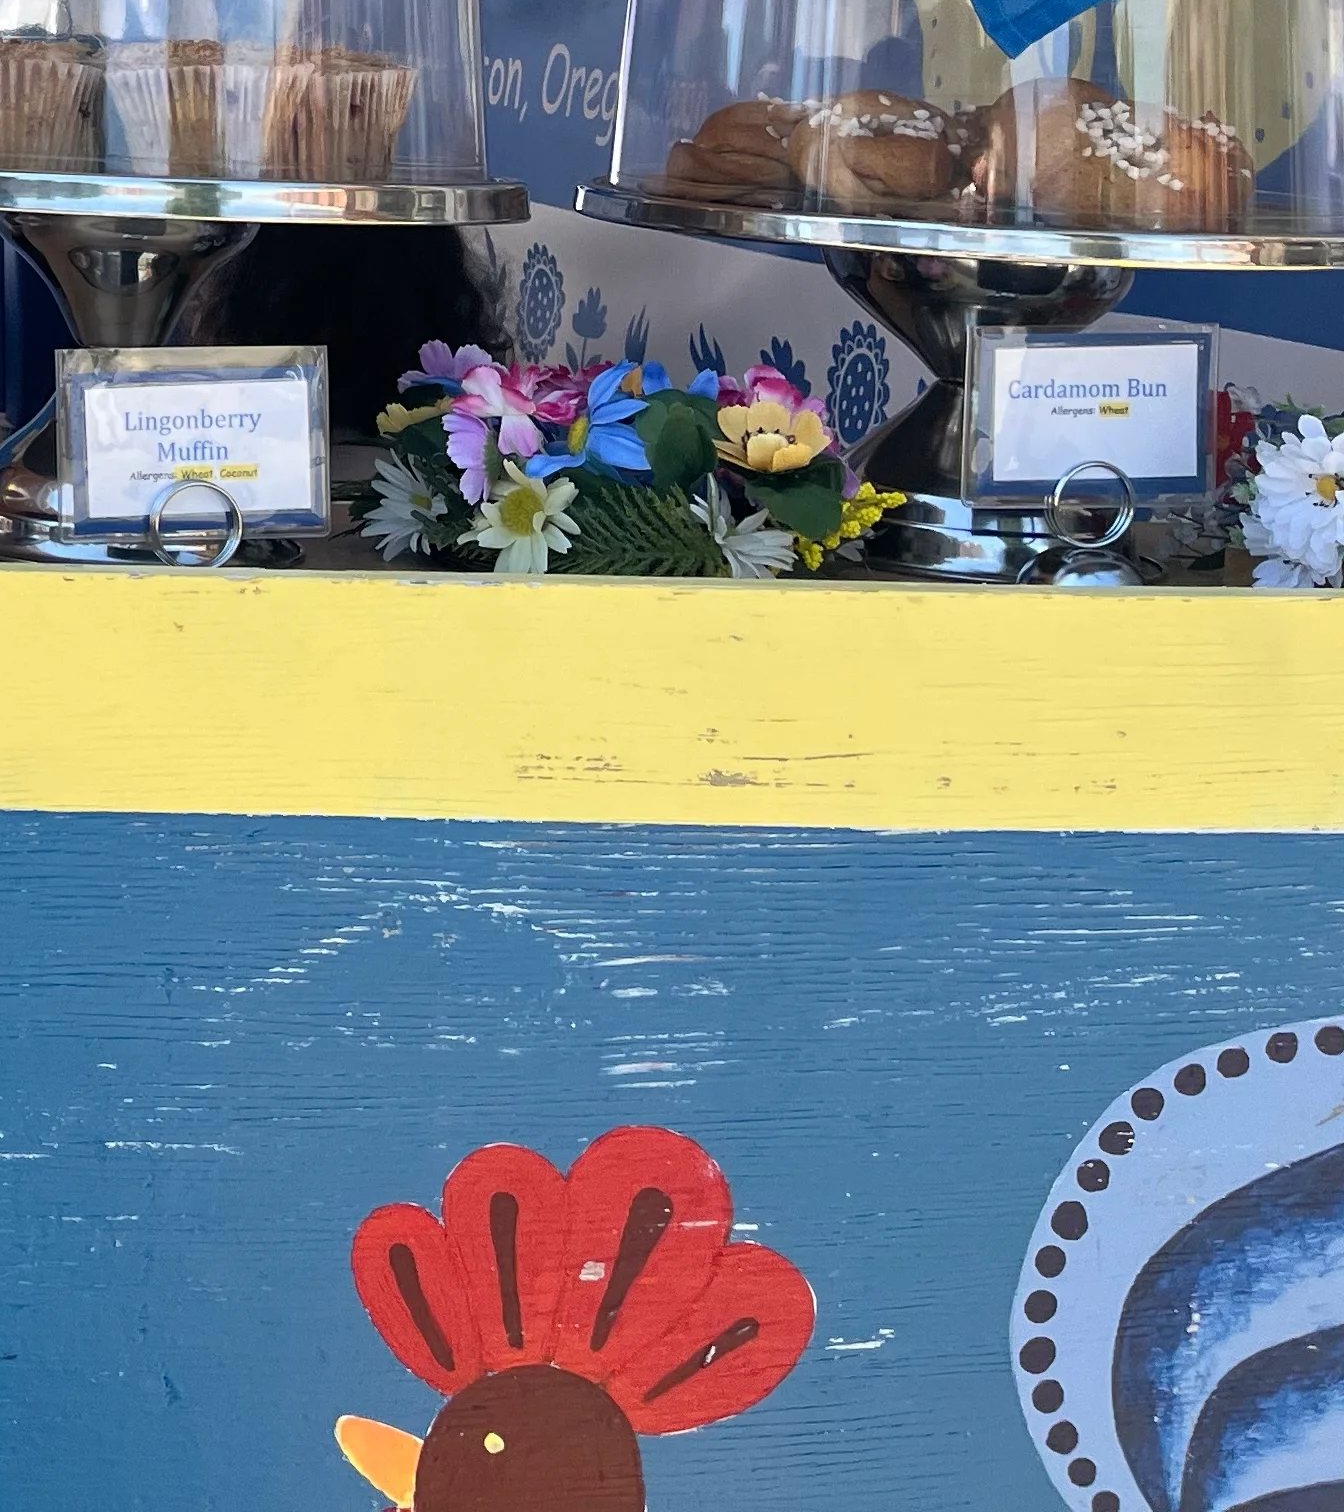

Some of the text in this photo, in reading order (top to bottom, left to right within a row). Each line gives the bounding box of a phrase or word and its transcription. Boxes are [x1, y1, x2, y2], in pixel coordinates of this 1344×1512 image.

[1008, 377, 1168, 400] Cardamom Bun
[124, 408, 262, 437] Lingonberry
[1050, 405, 1130, 418] Allergens: Wheat
[157, 440, 230, 463] Muffin
[219, 467, 259, 479] Coconut
